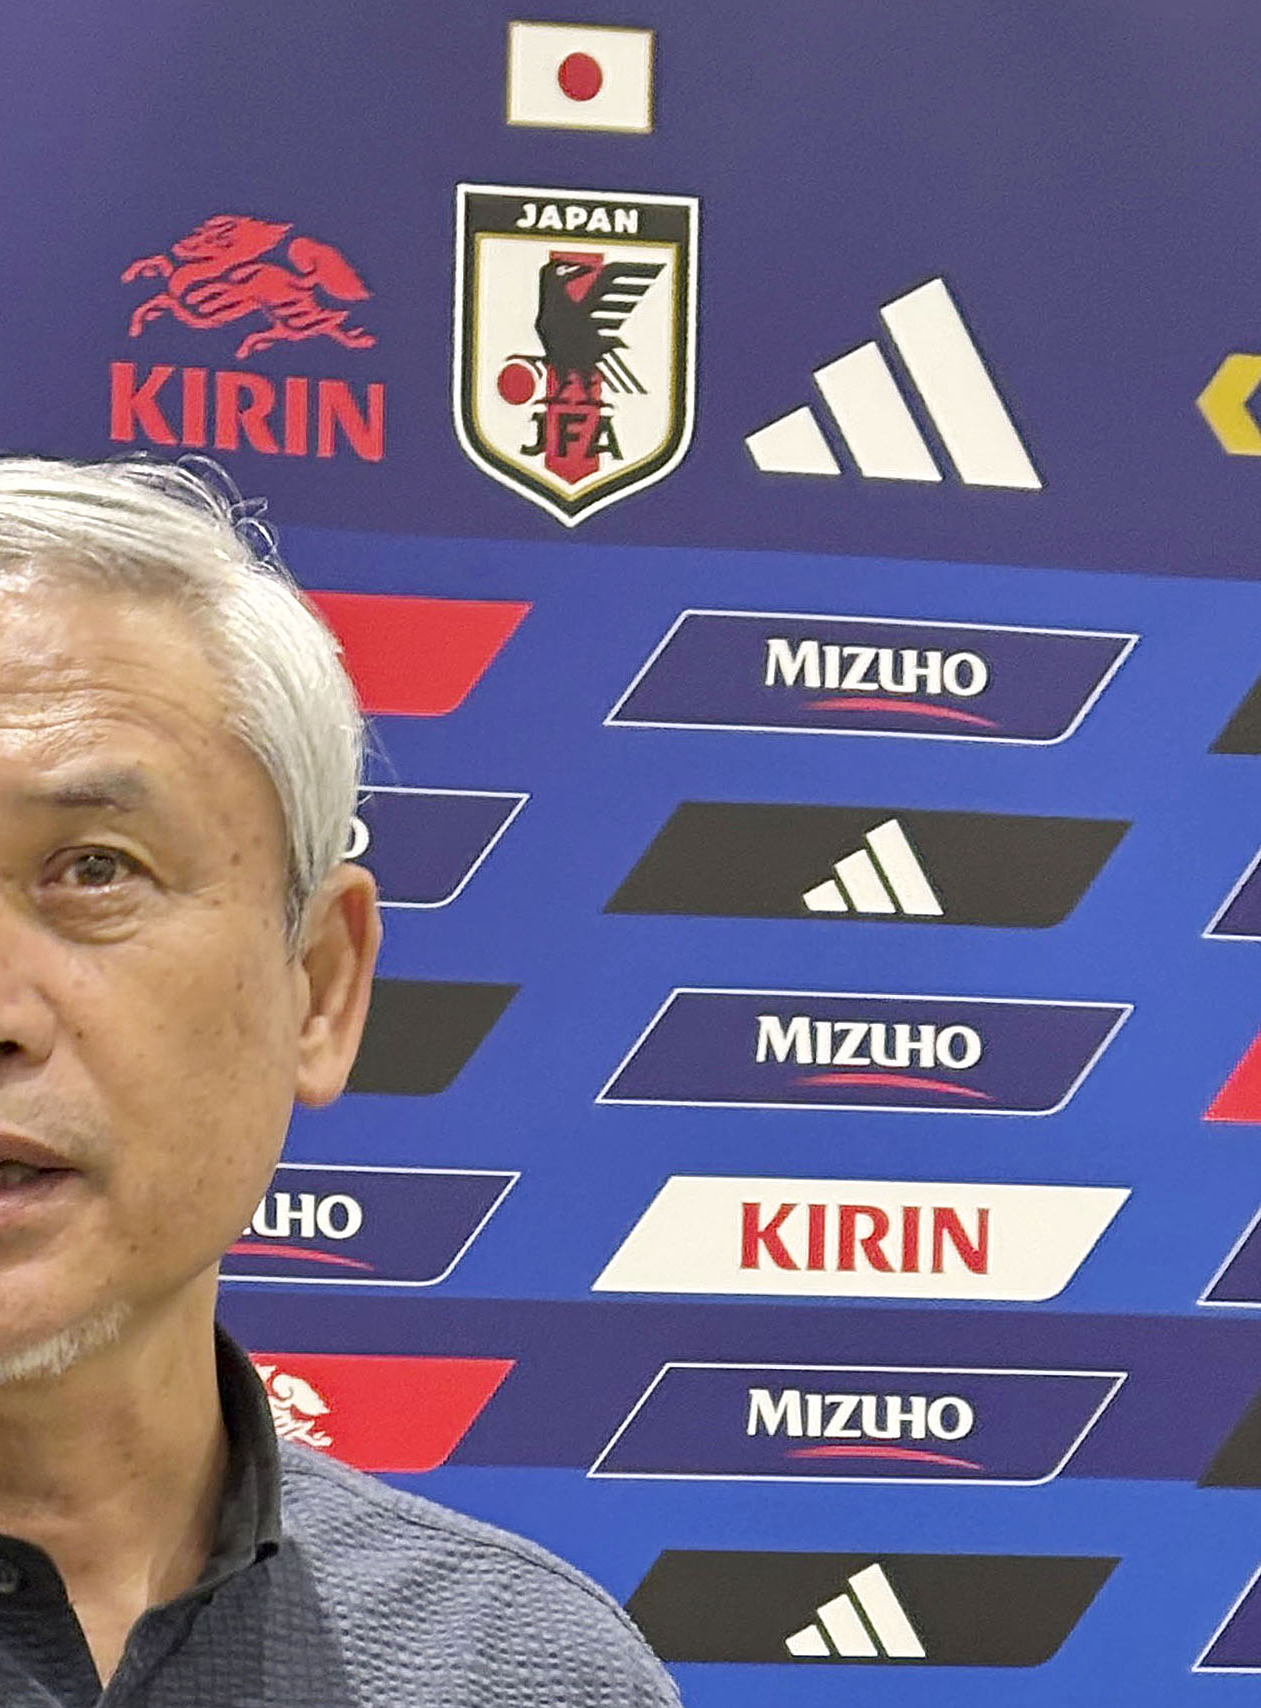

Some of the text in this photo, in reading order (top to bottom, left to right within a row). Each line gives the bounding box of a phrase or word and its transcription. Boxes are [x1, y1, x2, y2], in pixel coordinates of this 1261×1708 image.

[515, 203, 639, 234] JAPAN
[109, 361, 385, 462] KIRIN
[520, 411, 624, 461] JFA
[764, 637, 988, 697] MIZUHO
[756, 1014, 982, 1069] MIZUHO
[740, 1202, 990, 1275] KIRIN
[746, 1388, 974, 1441] MIZUHO
